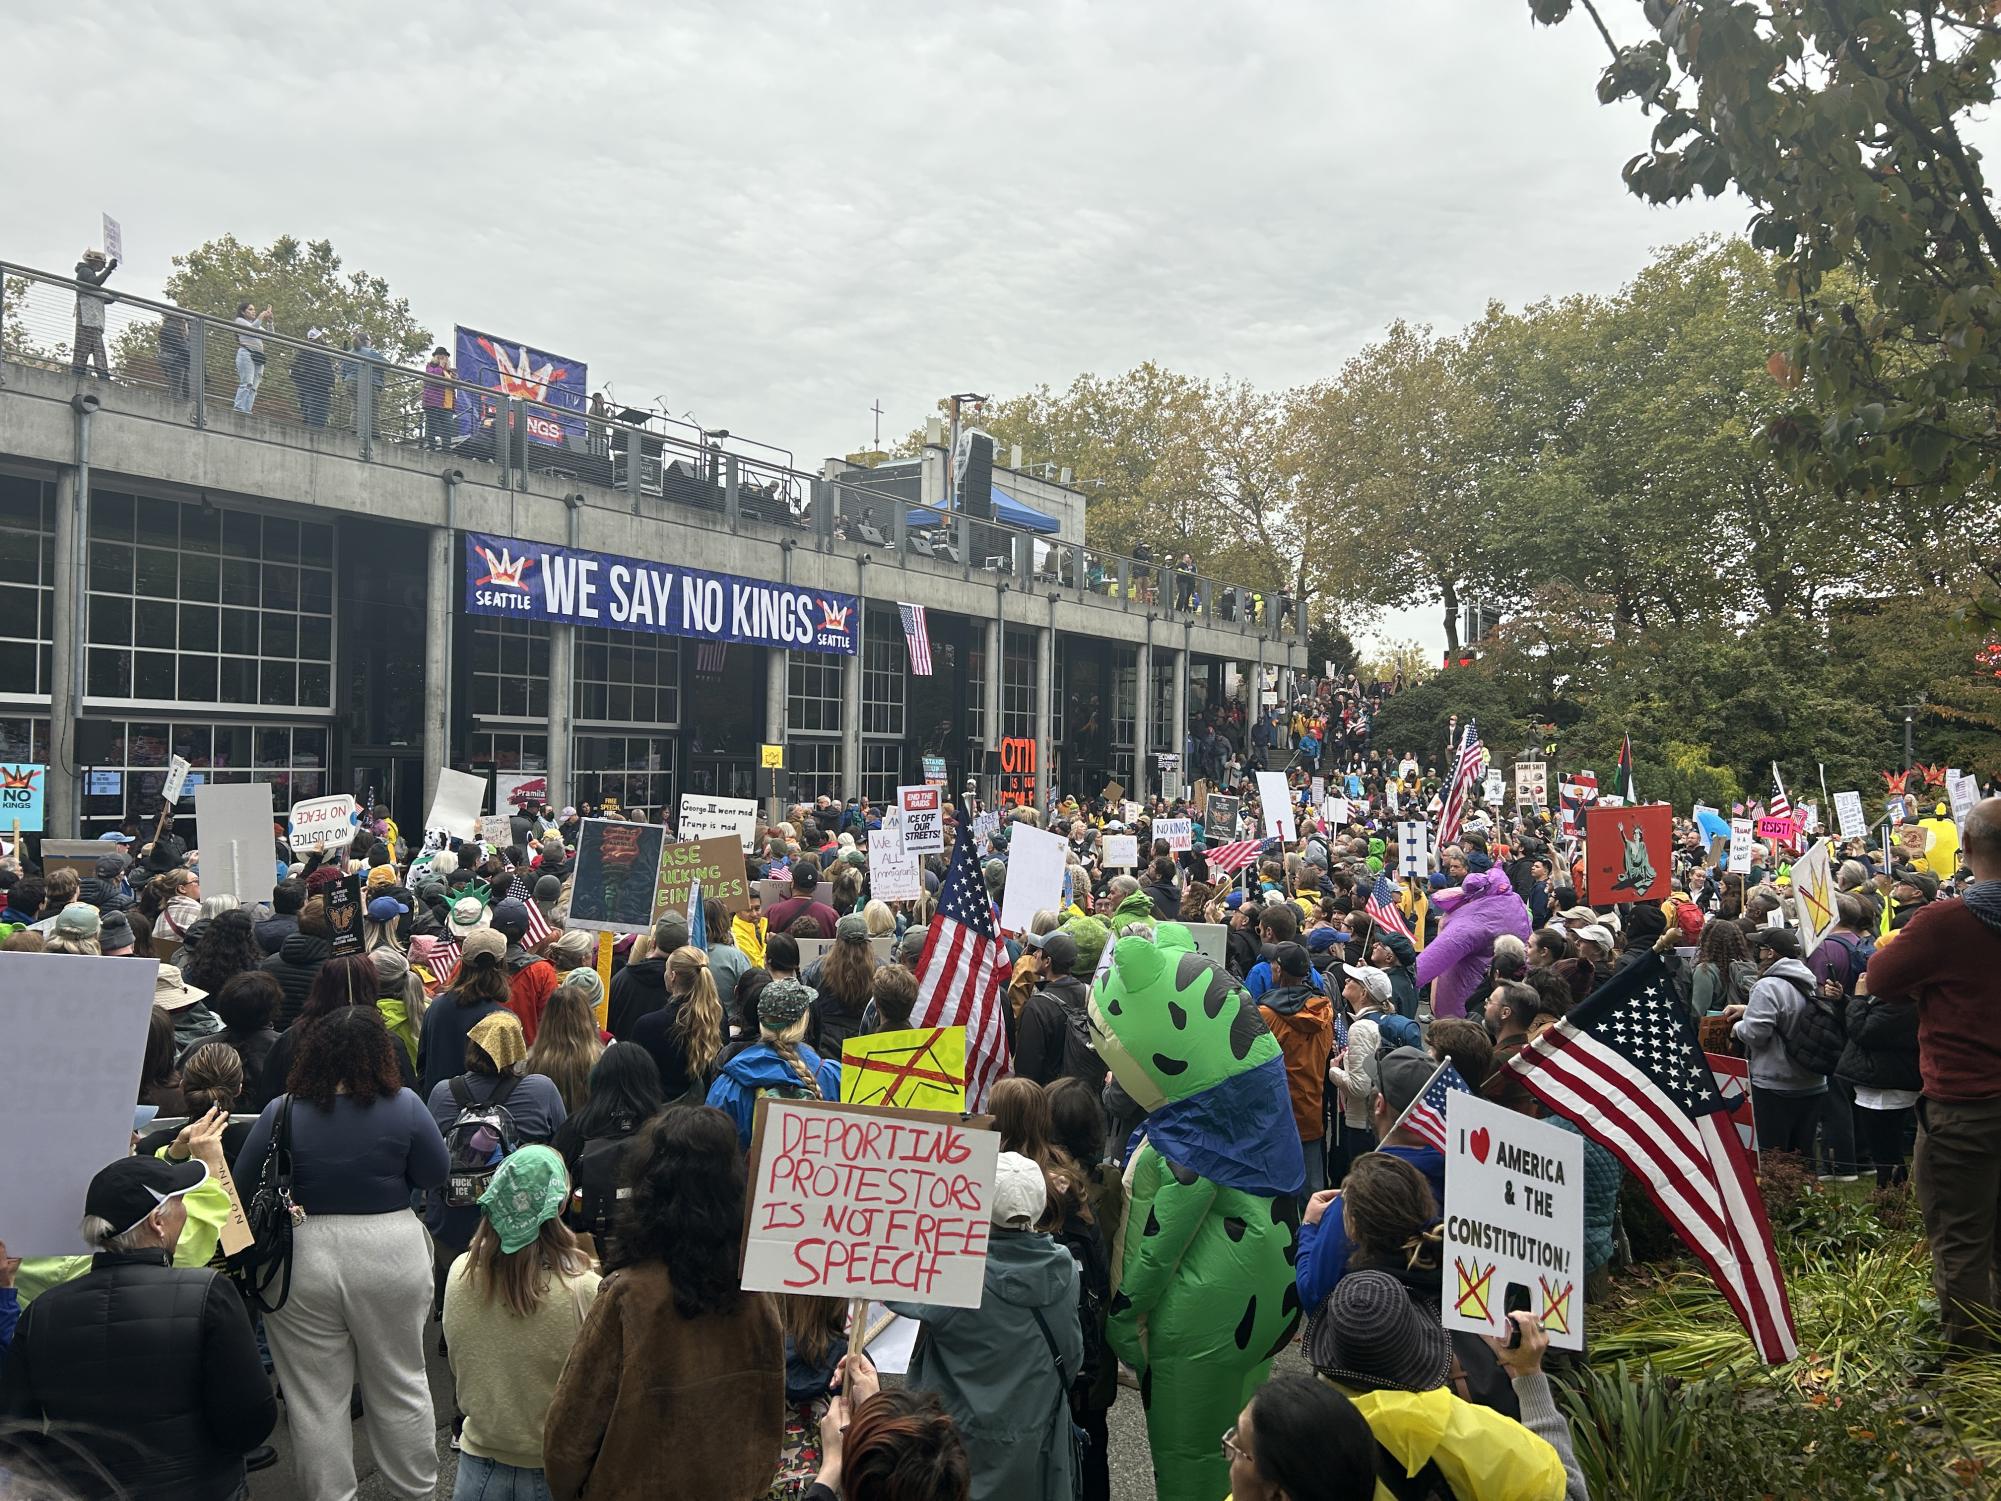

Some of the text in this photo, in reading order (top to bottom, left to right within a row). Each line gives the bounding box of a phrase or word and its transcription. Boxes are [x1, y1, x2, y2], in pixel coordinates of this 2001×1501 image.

[527, 416, 560, 438] NGS
[475, 590, 531, 610] SEATTLE
[541, 553, 814, 644] WE SAY NO KINGS
[817, 633, 850, 648] SEATTLE
[925, 758, 944, 766] STAND
[3, 790, 31, 802] NO
[517, 789, 546, 797] Pramila
[906, 791, 934, 801] END THE
[682, 800, 707, 815] George
[707, 803, 718, 814] III
[738, 807, 754, 817] mad
[911, 799, 930, 808] RAIDS
[296, 804, 347, 825] NO PEACE
[907, 813, 936, 824] ICE OFF
[680, 815, 737, 831] Trump is mad
[914, 822, 930, 832] OUR
[1156, 822, 1190, 835] NO KINGS
[1734, 826, 1751, 835] TRUMP
[1762, 821, 1790, 835] RESIST!
[292, 827, 348, 847] NO JUSTICE
[871, 835, 892, 850] We
[905, 830, 941, 841] STREETS!
[663, 845, 701, 867] ASE
[882, 852, 904, 865] ALL
[656, 887, 689, 907] EIN
[783, 1112, 972, 1165] DEPORTING
[1460, 1128, 1565, 1186] I AMERICA
[451, 1177, 472, 1187] FUCK
[769, 1153, 982, 1211] PROTESTORS
[455, 1187, 469, 1196] ICE
[1504, 1180, 1553, 1219] & THE
[232, 1203, 244, 1225] NO
[762, 1202, 991, 1257] IS NOT FREE
[1448, 1215, 1570, 1274] CONSTITUTION!
[783, 1237, 943, 1294] SPEECH
